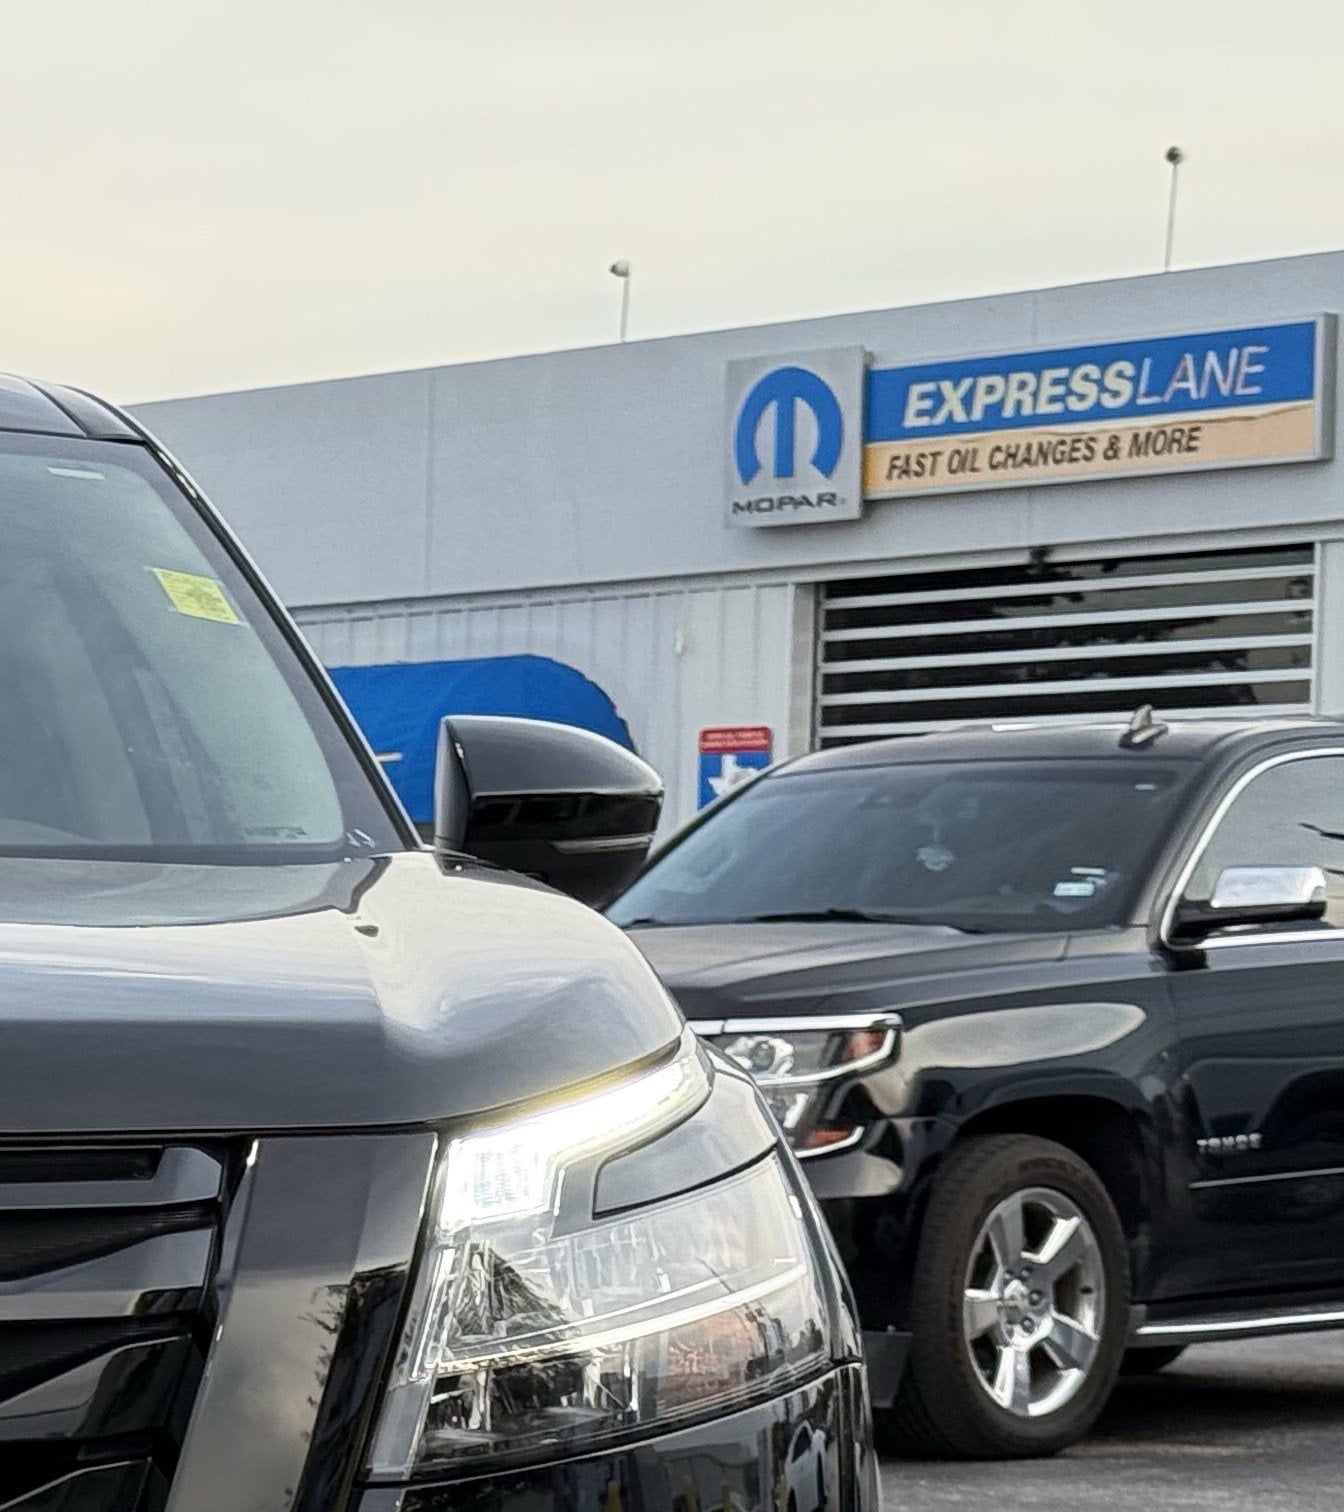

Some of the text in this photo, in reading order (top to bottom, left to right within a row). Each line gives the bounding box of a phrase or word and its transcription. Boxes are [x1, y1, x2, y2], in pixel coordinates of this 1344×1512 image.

[886, 426, 1202, 481] FAST OIL CHANGES & MORE
[731, 491, 838, 515] MOPAR
